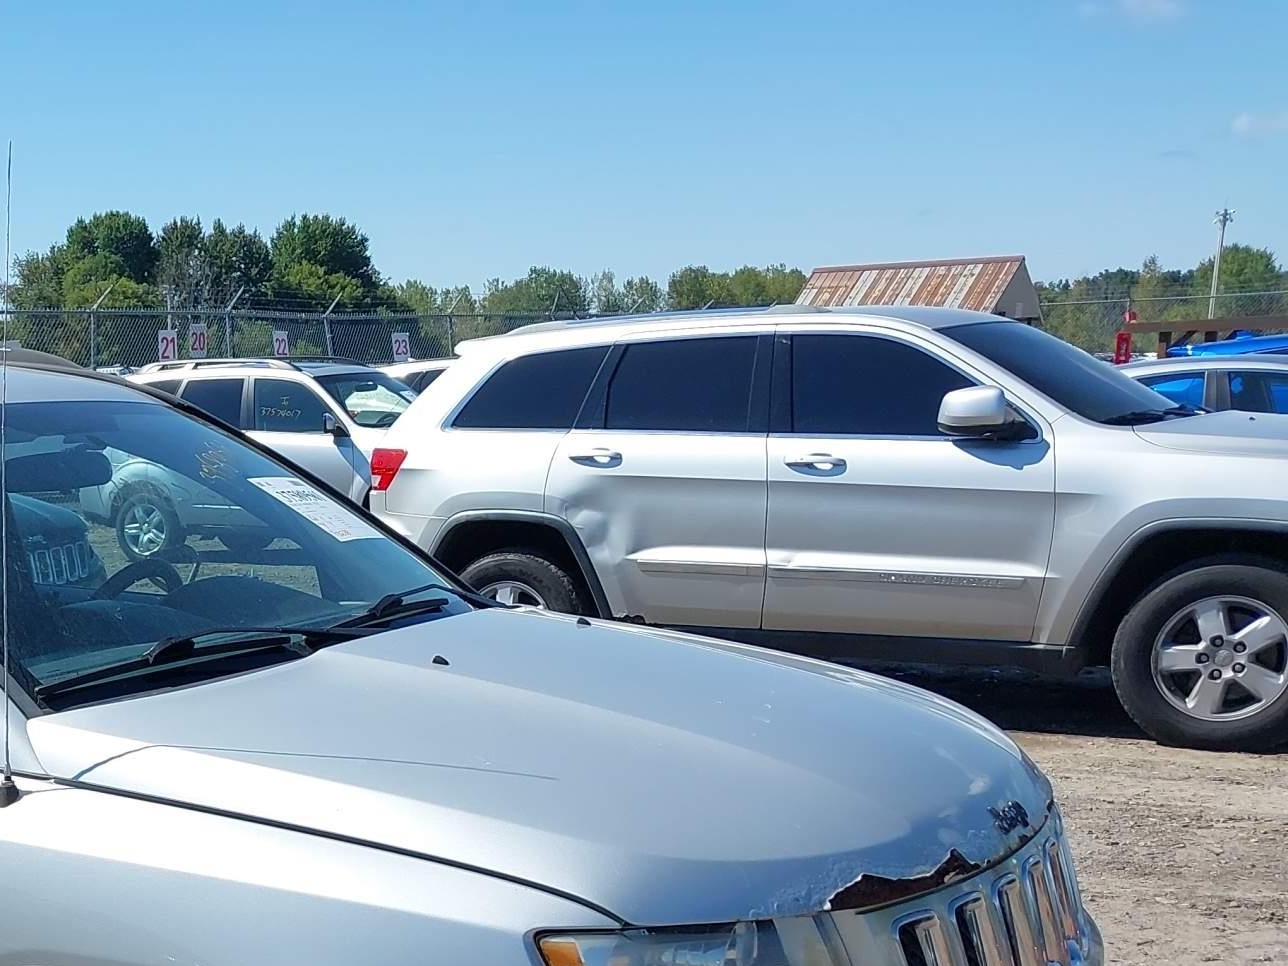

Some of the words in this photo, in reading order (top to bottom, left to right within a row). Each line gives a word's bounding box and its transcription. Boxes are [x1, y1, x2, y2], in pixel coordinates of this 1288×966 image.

[161, 336, 176, 359] 21
[192, 332, 206, 351] 20
[275, 338, 288, 355] 22
[394, 339, 409, 355] 23
